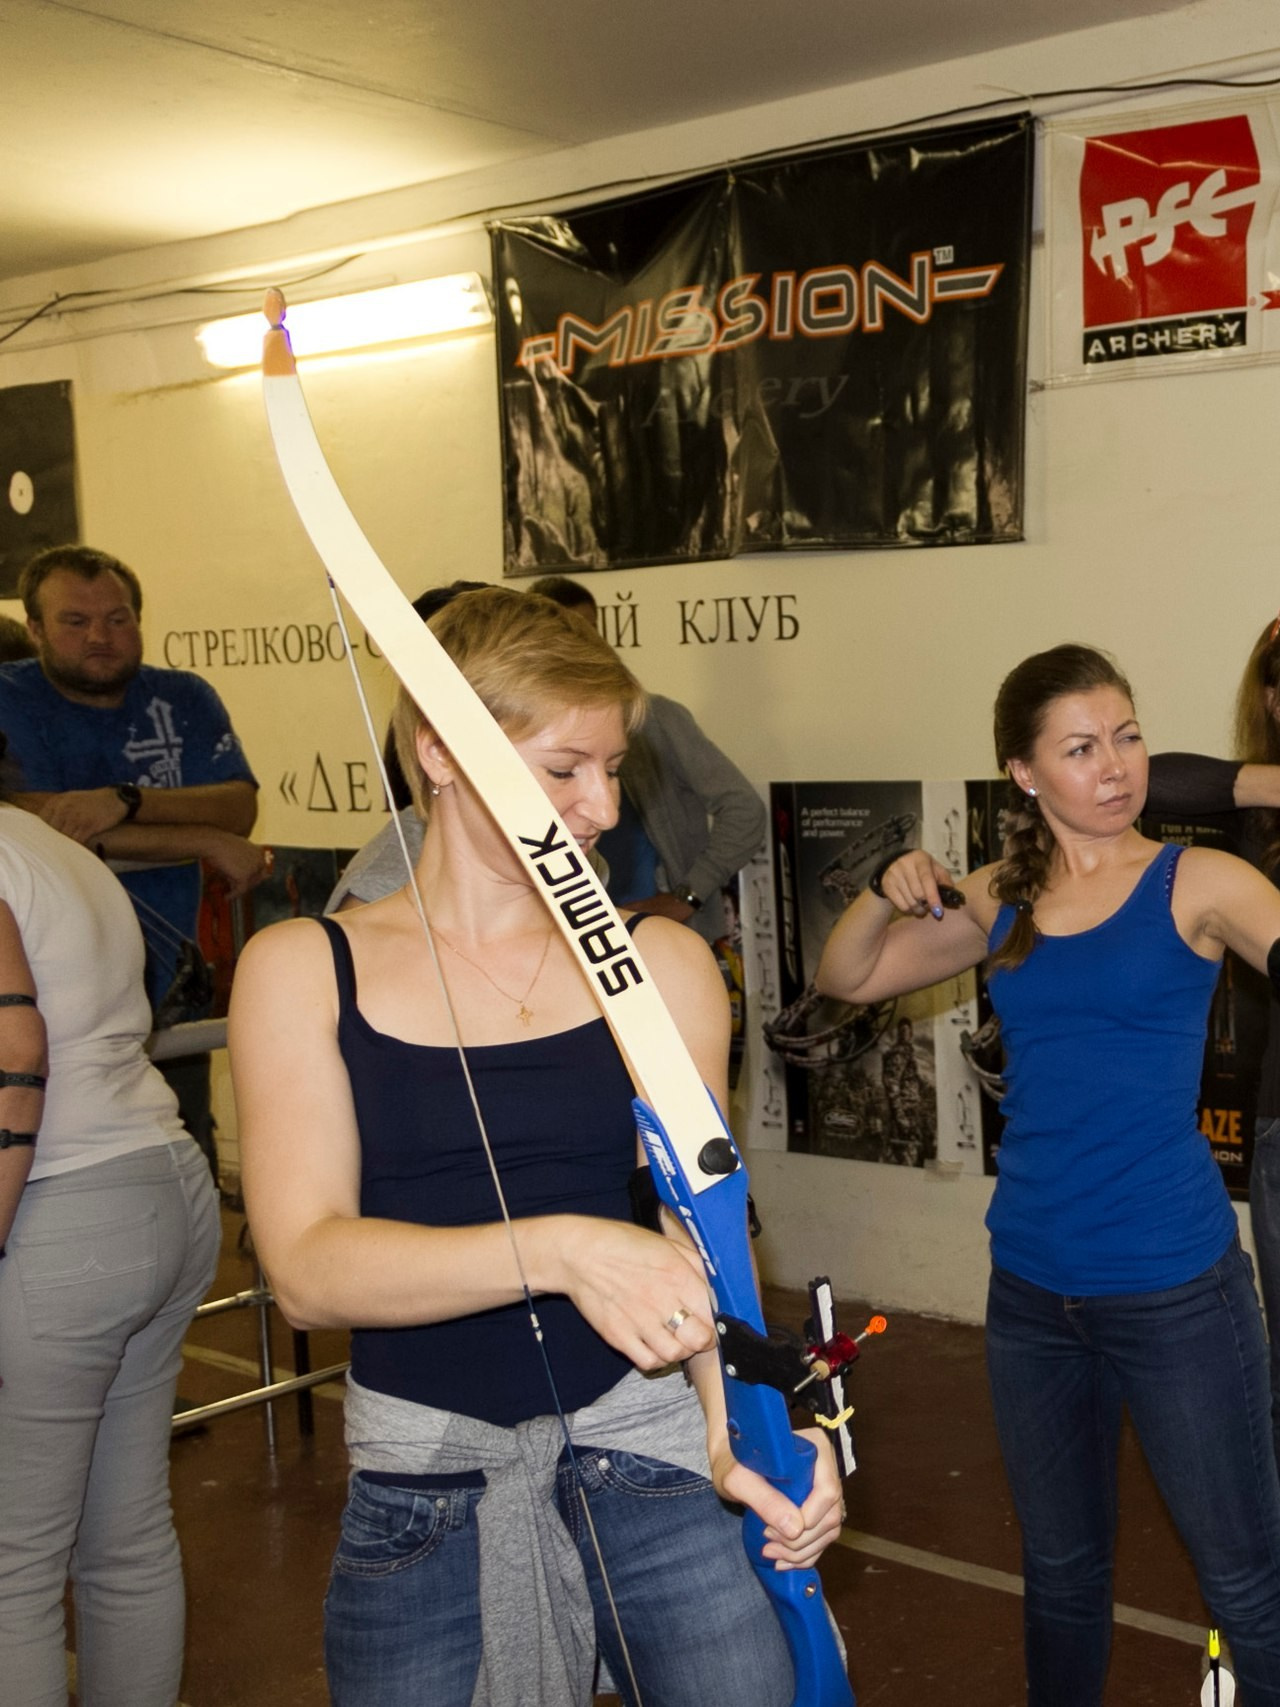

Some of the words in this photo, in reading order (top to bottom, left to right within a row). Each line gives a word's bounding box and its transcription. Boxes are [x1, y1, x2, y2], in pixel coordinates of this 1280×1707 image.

[516, 249, 1004, 374] MISSION
[1087, 320, 1242, 357] ARCHERY
[676, 594, 800, 645] КЛУБ
[517, 819, 645, 998] SAMICK
[1200, 1108, 1243, 1144] AZE
[1212, 1150, 1243, 1162] ION
